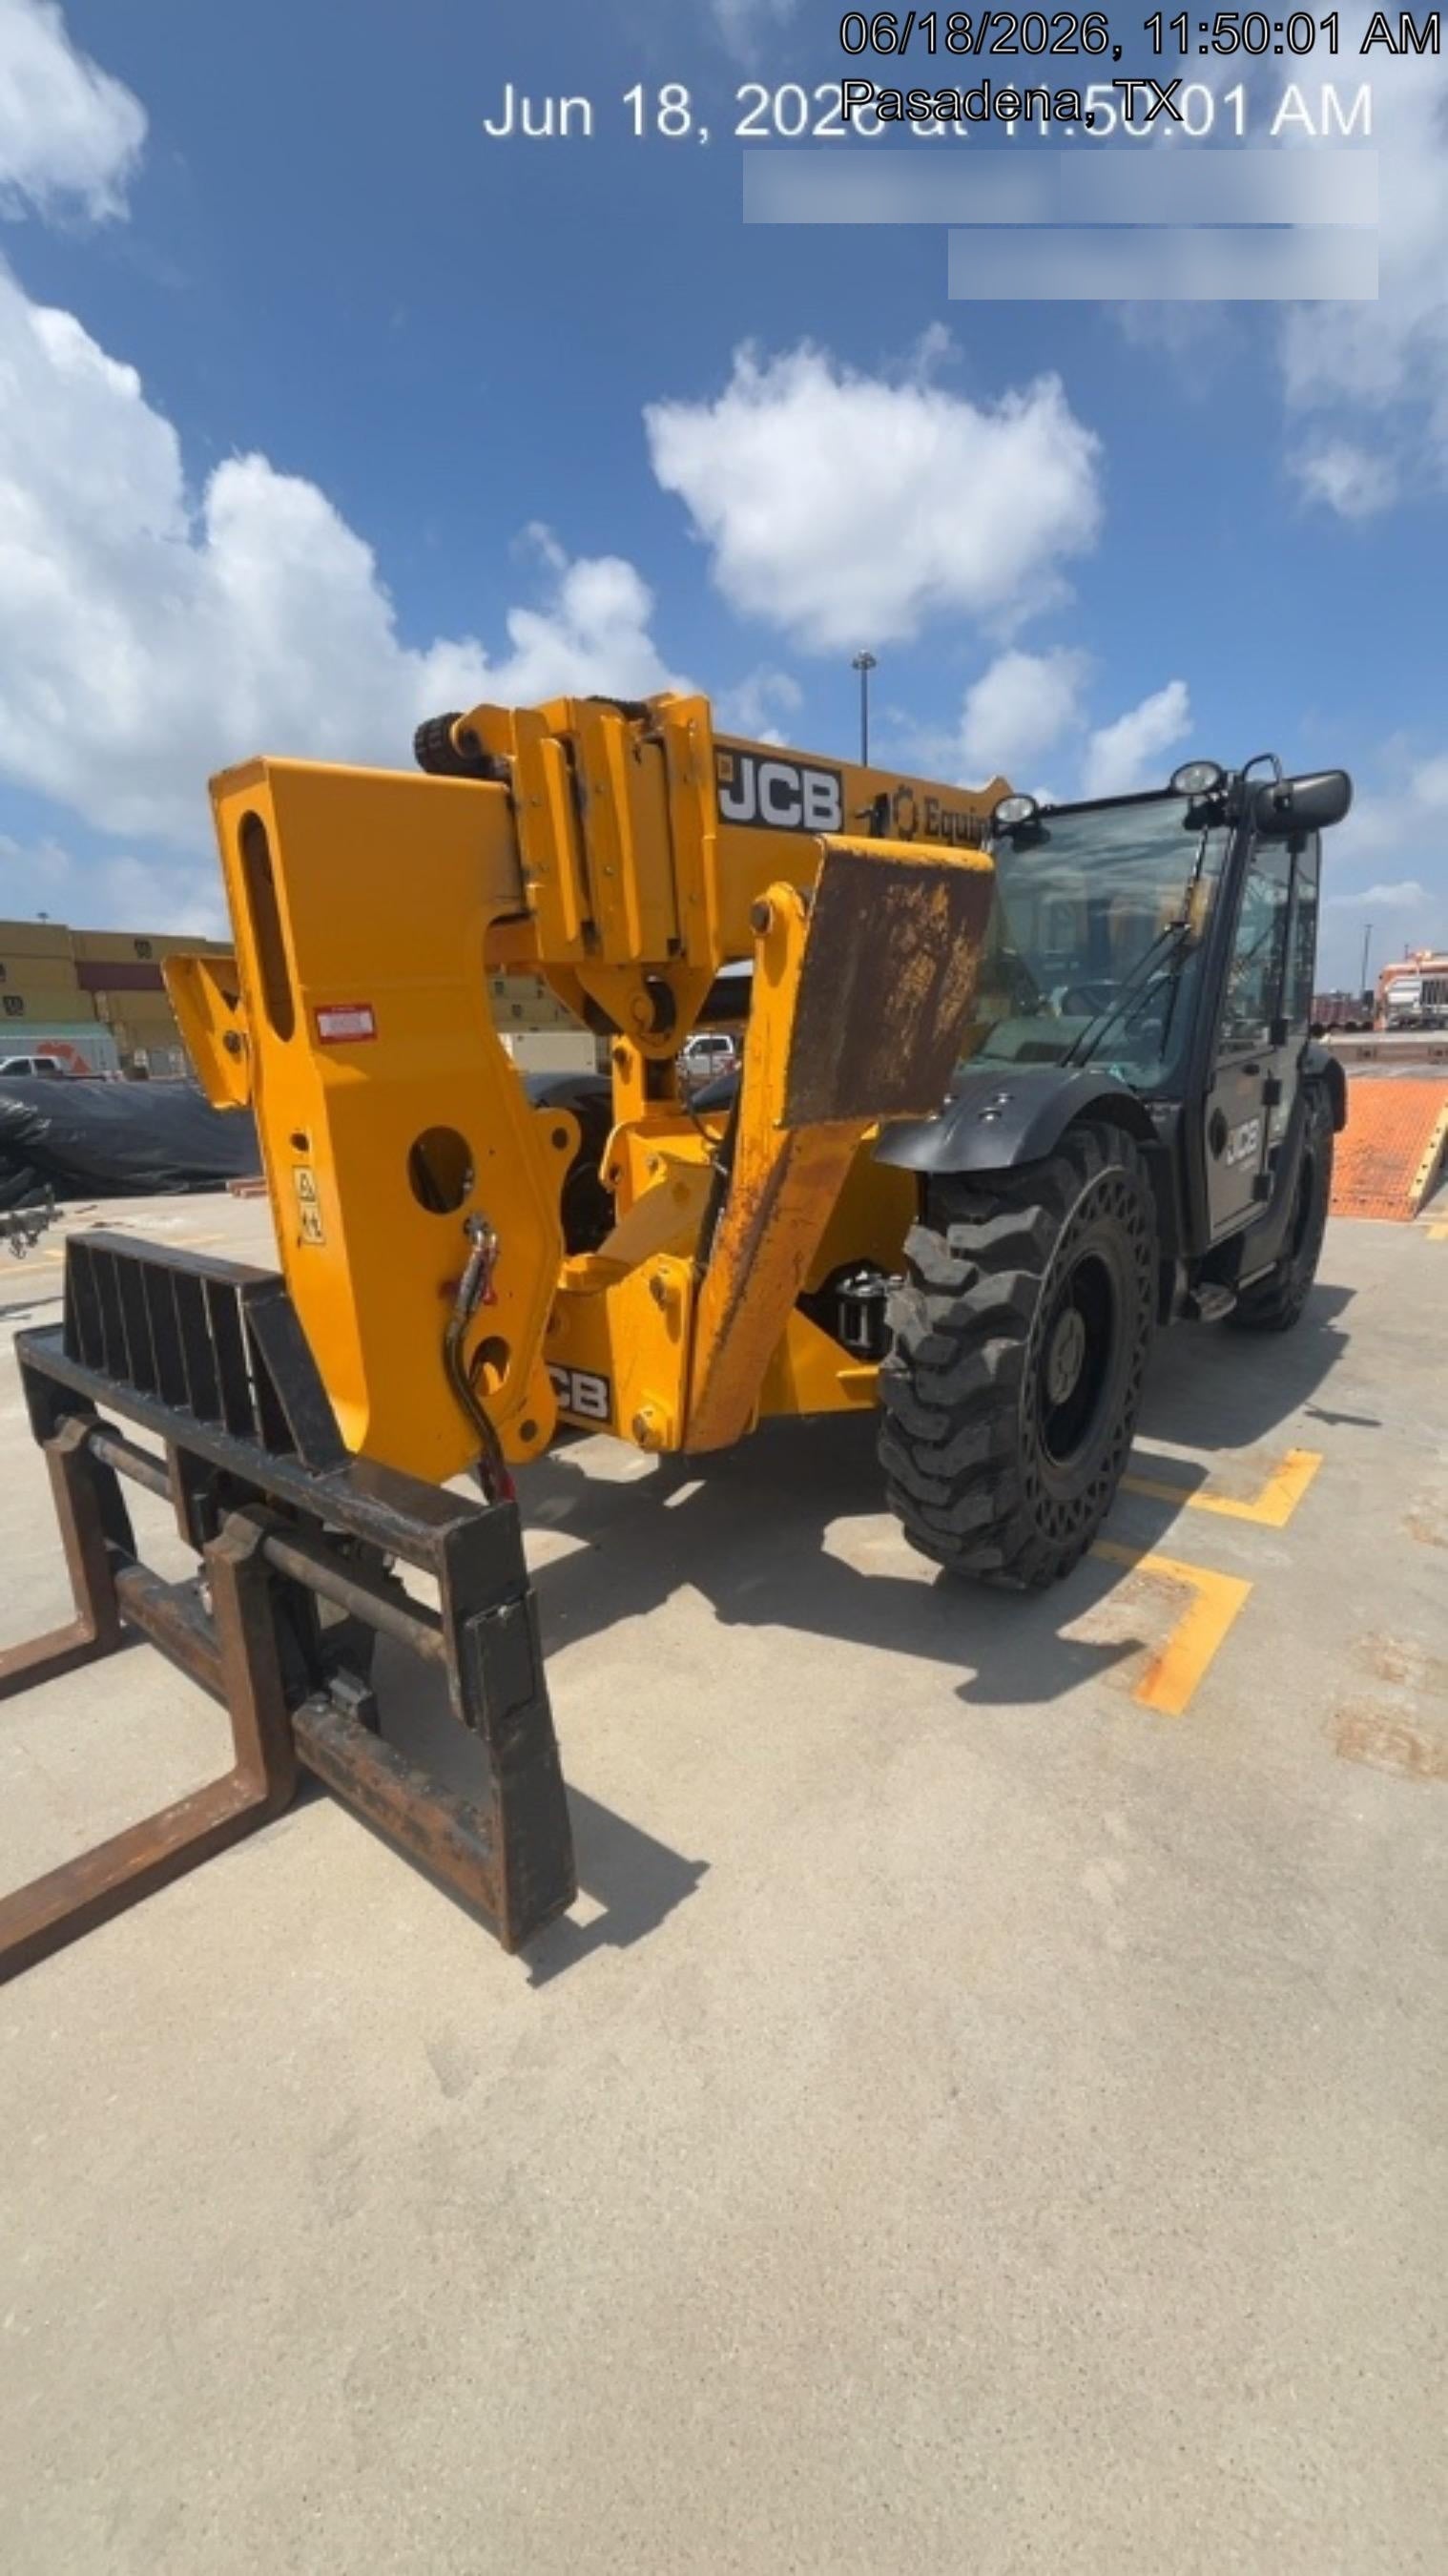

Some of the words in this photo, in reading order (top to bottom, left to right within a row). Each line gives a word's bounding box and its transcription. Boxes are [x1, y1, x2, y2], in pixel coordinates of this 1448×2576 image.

[718, 758, 842, 831] JCB
[1227, 1118, 1260, 1166] JCB
[548, 1366, 609, 1419] CB
